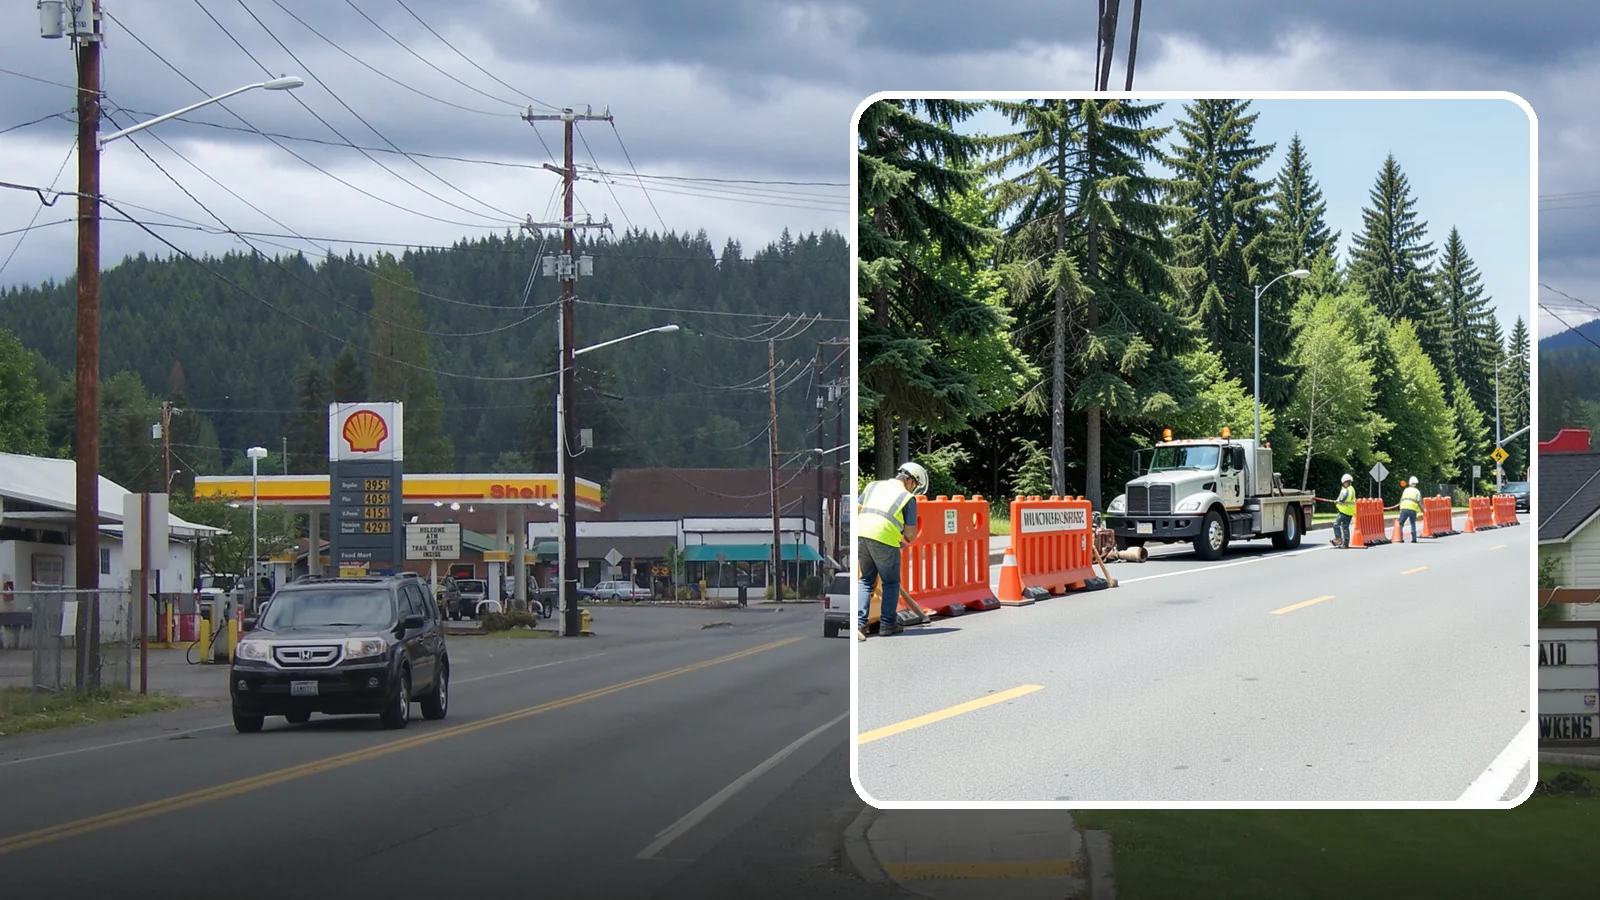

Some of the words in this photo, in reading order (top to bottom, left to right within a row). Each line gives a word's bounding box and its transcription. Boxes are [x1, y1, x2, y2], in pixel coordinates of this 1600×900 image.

[366, 480, 383, 490] 395
[489, 484, 547, 499] Shell
[365, 494, 383, 504] 405
[365, 508, 383, 518] 415
[366, 522, 383, 532] 429
